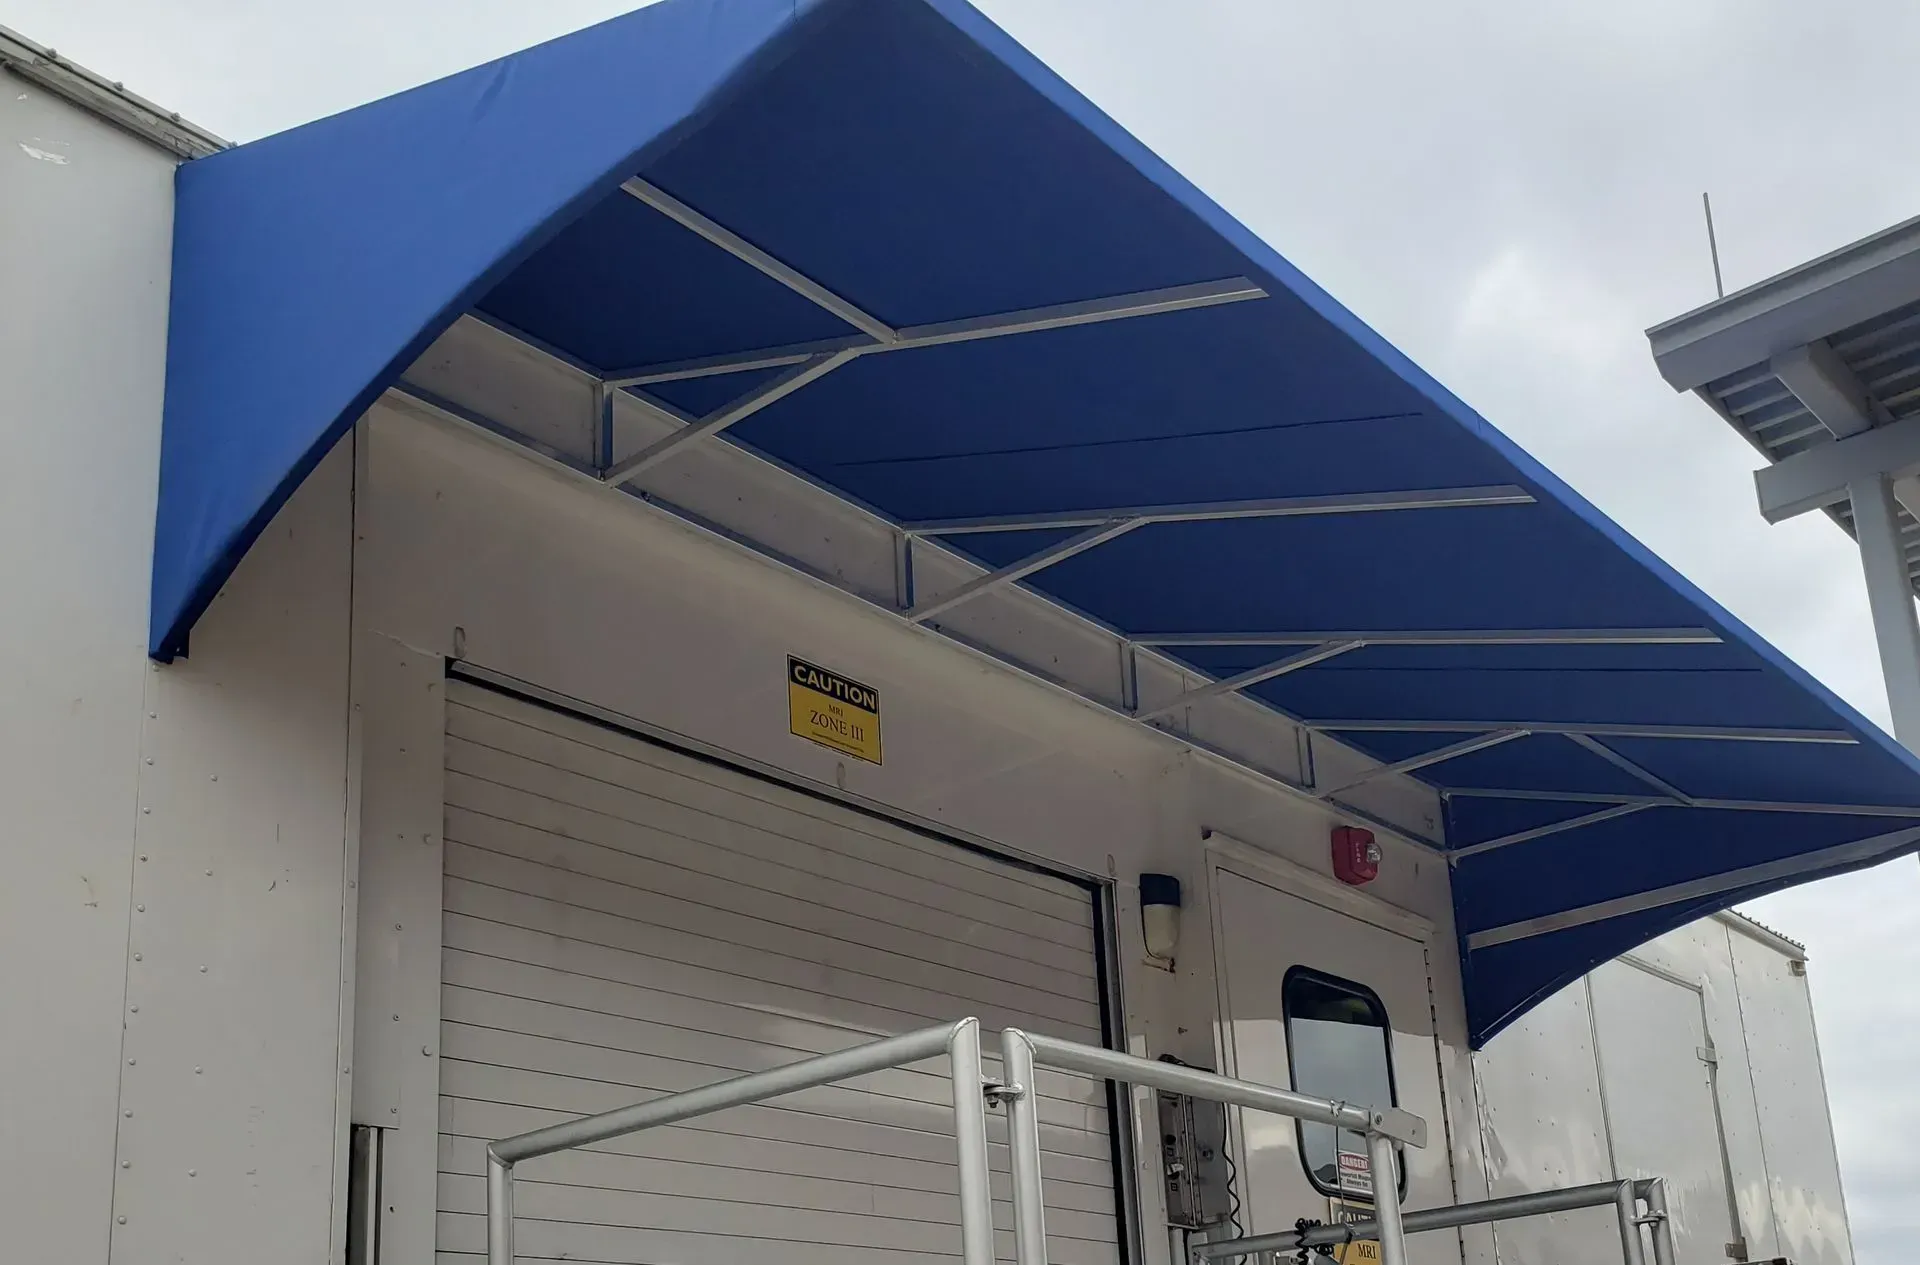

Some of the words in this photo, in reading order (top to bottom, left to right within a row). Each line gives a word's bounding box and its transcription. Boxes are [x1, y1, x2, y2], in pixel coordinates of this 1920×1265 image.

[795, 665, 875, 710] CAUTION
[829, 705, 843, 717] MRI
[810, 710, 847, 735] ZONE
[851, 725, 864, 742] III
[1357, 1243, 1377, 1259] MRI
